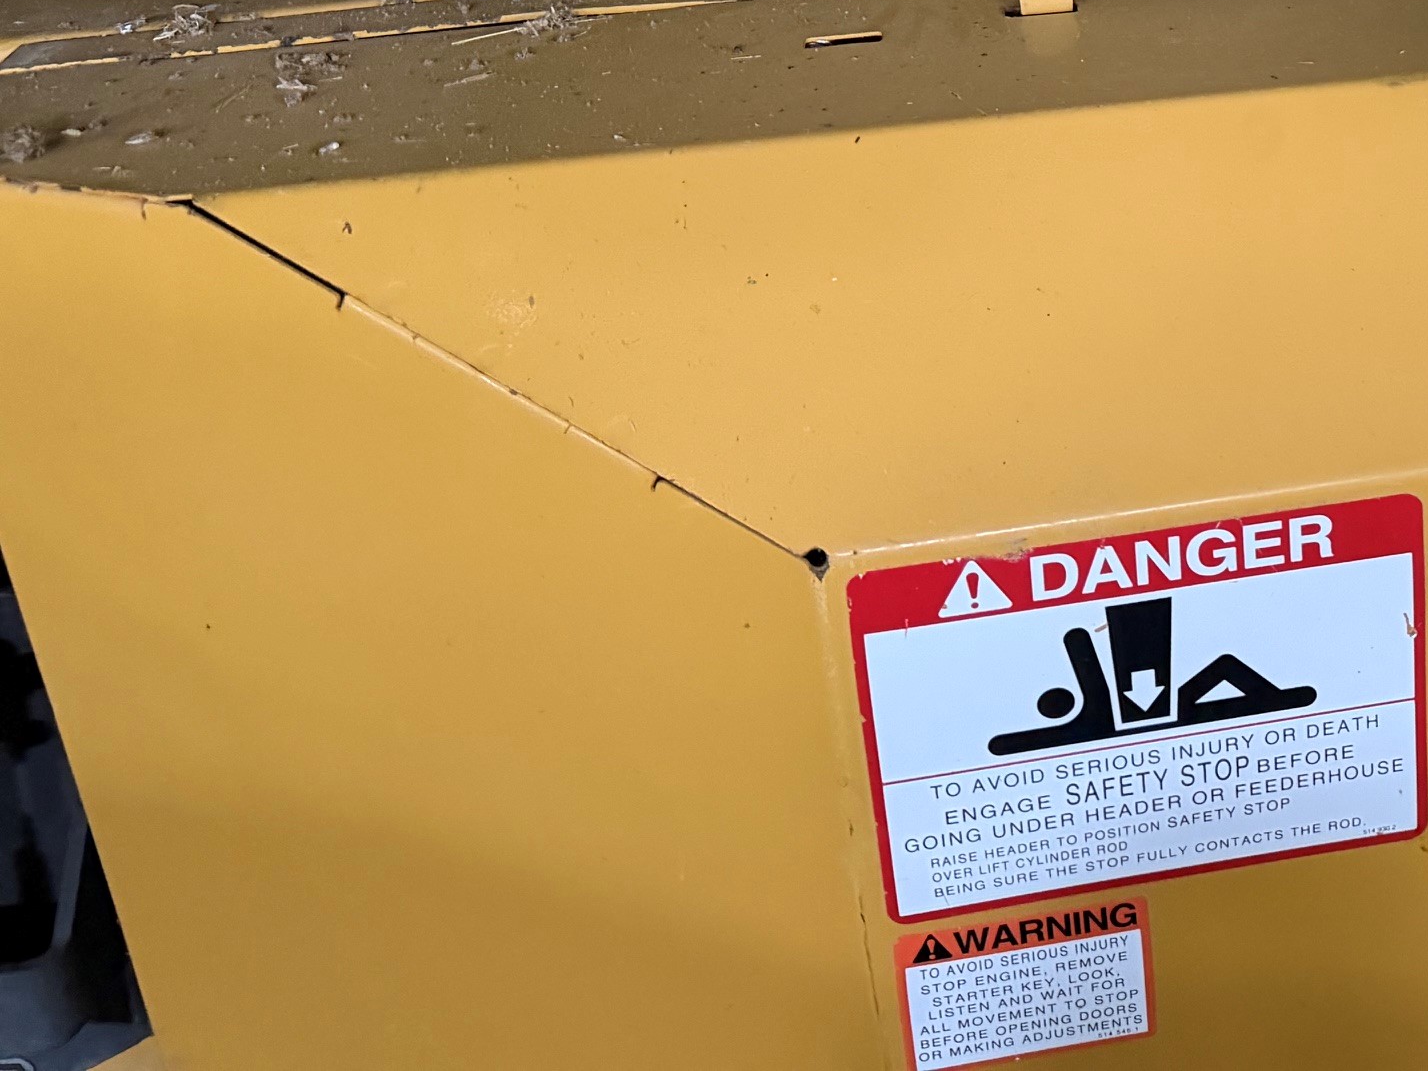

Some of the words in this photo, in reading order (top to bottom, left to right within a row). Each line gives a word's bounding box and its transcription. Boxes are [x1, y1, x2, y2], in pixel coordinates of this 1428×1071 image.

[1029, 514, 1334, 601] DANGER
[930, 783, 961, 799] TO
[972, 769, 1045, 793] AVOID
[1056, 749, 1161, 779] SERIOUS
[1172, 734, 1254, 760] INJURY
[1265, 728, 1296, 745] OR
[1307, 714, 1379, 739] DEATH
[904, 828, 981, 853] GOING
[993, 813, 1075, 839] UNDER
[1085, 794, 1182, 823] HEADER
[1193, 788, 1224, 805] OR
[1236, 759, 1404, 799] FEEDERHOUSE
[945, 795, 1052, 825] ENGAGE
[1066, 769, 1168, 805] SAFETY
[1181, 756, 1249, 787] STOP
[1257, 745, 1354, 773] BEFORE
[931, 852, 978, 868] RAISE
[985, 839, 1050, 859] HEADER
[1057, 834, 1077, 847] TO
[1085, 821, 1160, 843] POSITION
[1168, 807, 1236, 828] SAFETY
[1244, 798, 1291, 815] STOP
[935, 881, 986, 898] BEING
[993, 872, 1039, 888] SURE
[1046, 867, 1078, 878] THE
[1086, 856, 1129, 872] STOP
[1137, 846, 1188, 862] FULLY
[1195, 830, 1284, 853] CONTACTS
[1291, 823, 1321, 837] THE
[1328, 817, 1366, 831] ROD.
[932, 867, 973, 883] OVER
[979, 860, 1009, 875] LIFT
[1016, 848, 1090, 869] CYLINDER
[1097, 841, 1128, 855] ROD
[953, 903, 1137, 954] WARNING
[920, 967, 939, 980] TO
[947, 959, 993, 976] AVOID
[1001, 945, 1068, 966] SERIOUS
[1075, 935, 1128, 954] INJURY
[921, 979, 967, 995] STOP
[976, 966, 1047, 986] ENGINE,
[1056, 951, 1127, 972] REMOVE
[929, 1001, 989, 1020] LISTEN
[999, 994, 1032, 1007] AND
[1041, 985, 1082, 1000] WAIT
[1091, 978, 1125, 992] FOR
[933, 985, 1013, 1007] STARTER
[1022, 977, 1060, 992] KEY,
[1069, 967, 1120, 984] LOOK,
[920, 1023, 948, 1036] ALL
[958, 1003, 1056, 1029] MOVEMENT
[1065, 998, 1086, 1009] TO
[1095, 989, 1139, 1005] STOP
[921, 1029, 988, 1049] BEFORE
[996, 1014, 1072, 1036] OPENING
[1080, 1003, 1137, 1020] DOORS
[919, 1049, 942, 1063] OR
[949, 1037, 1014, 1057] MAKING
[1022, 1014, 1143, 1044] ADJUSTMENTS
